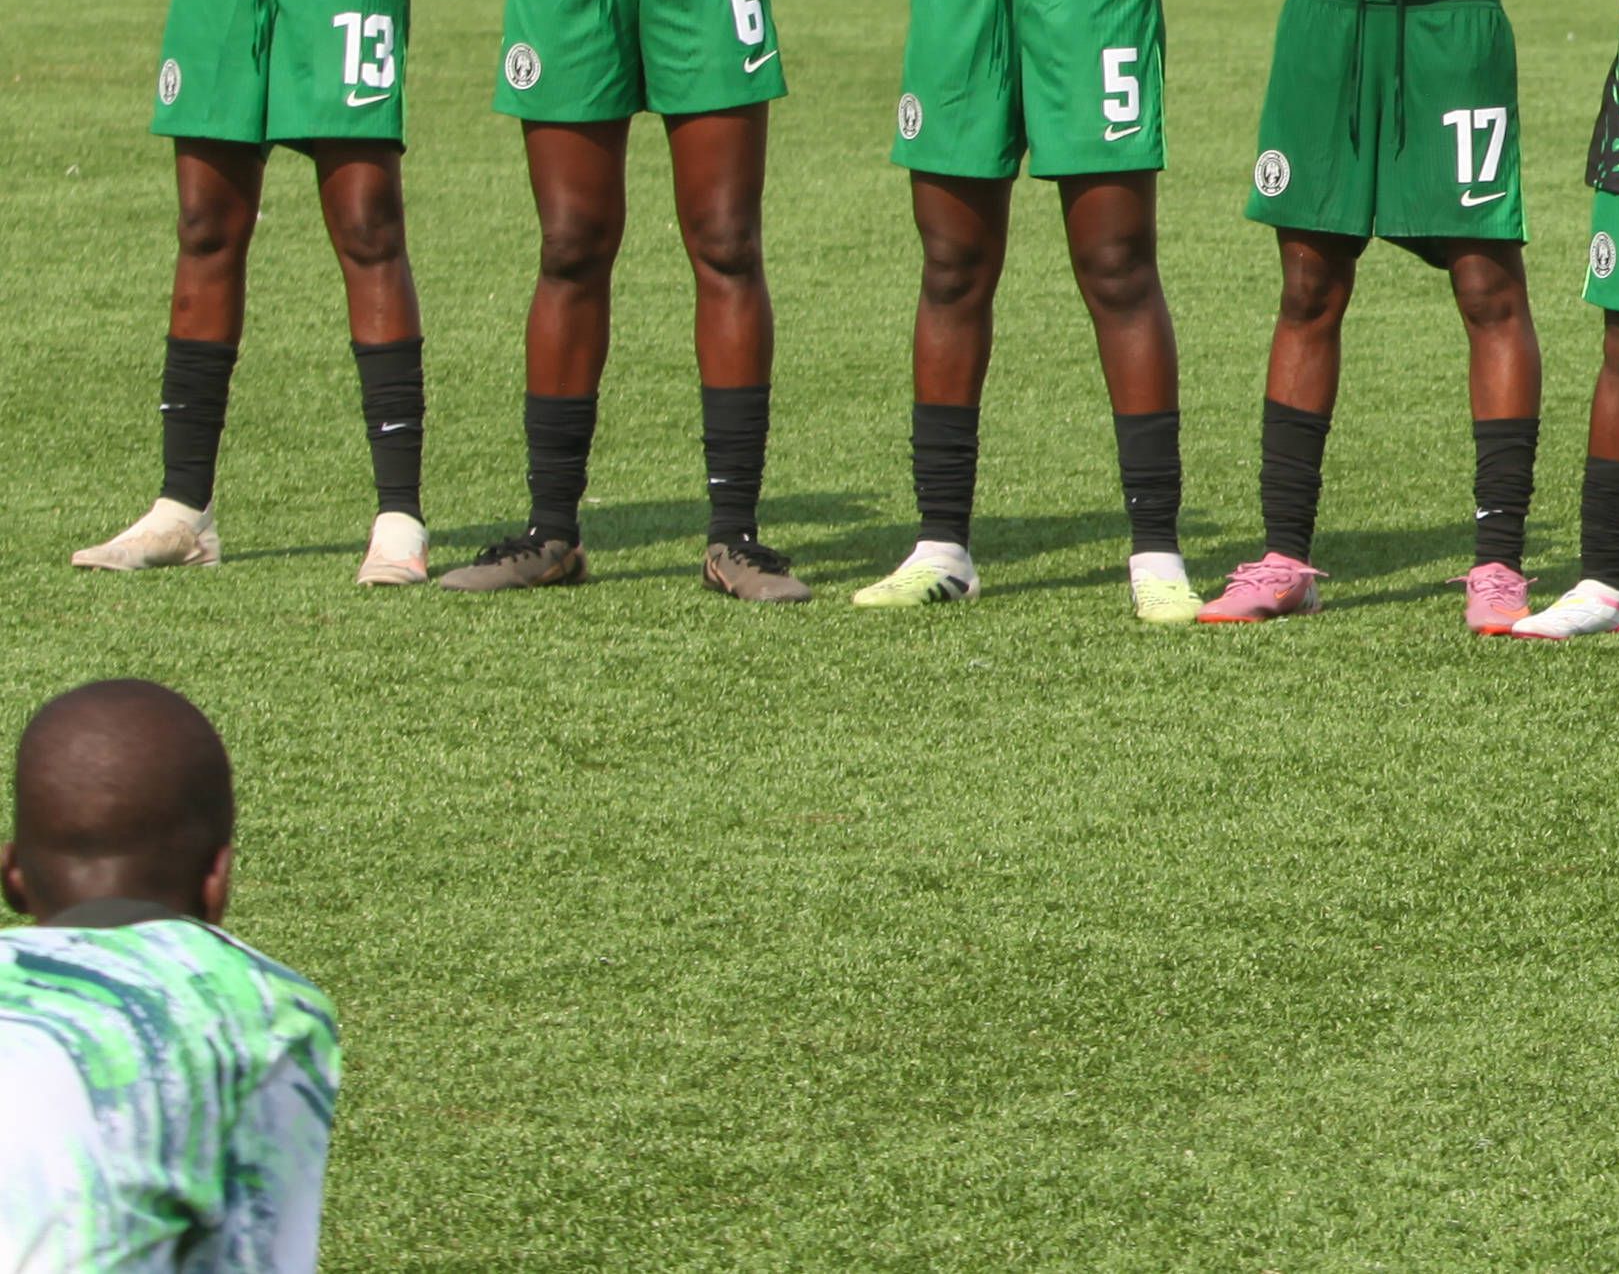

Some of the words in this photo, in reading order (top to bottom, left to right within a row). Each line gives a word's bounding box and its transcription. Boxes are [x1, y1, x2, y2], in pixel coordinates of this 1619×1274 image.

[332, 11, 396, 88] 13
[1102, 48, 1140, 124] 5
[1443, 107, 1508, 184] 17
